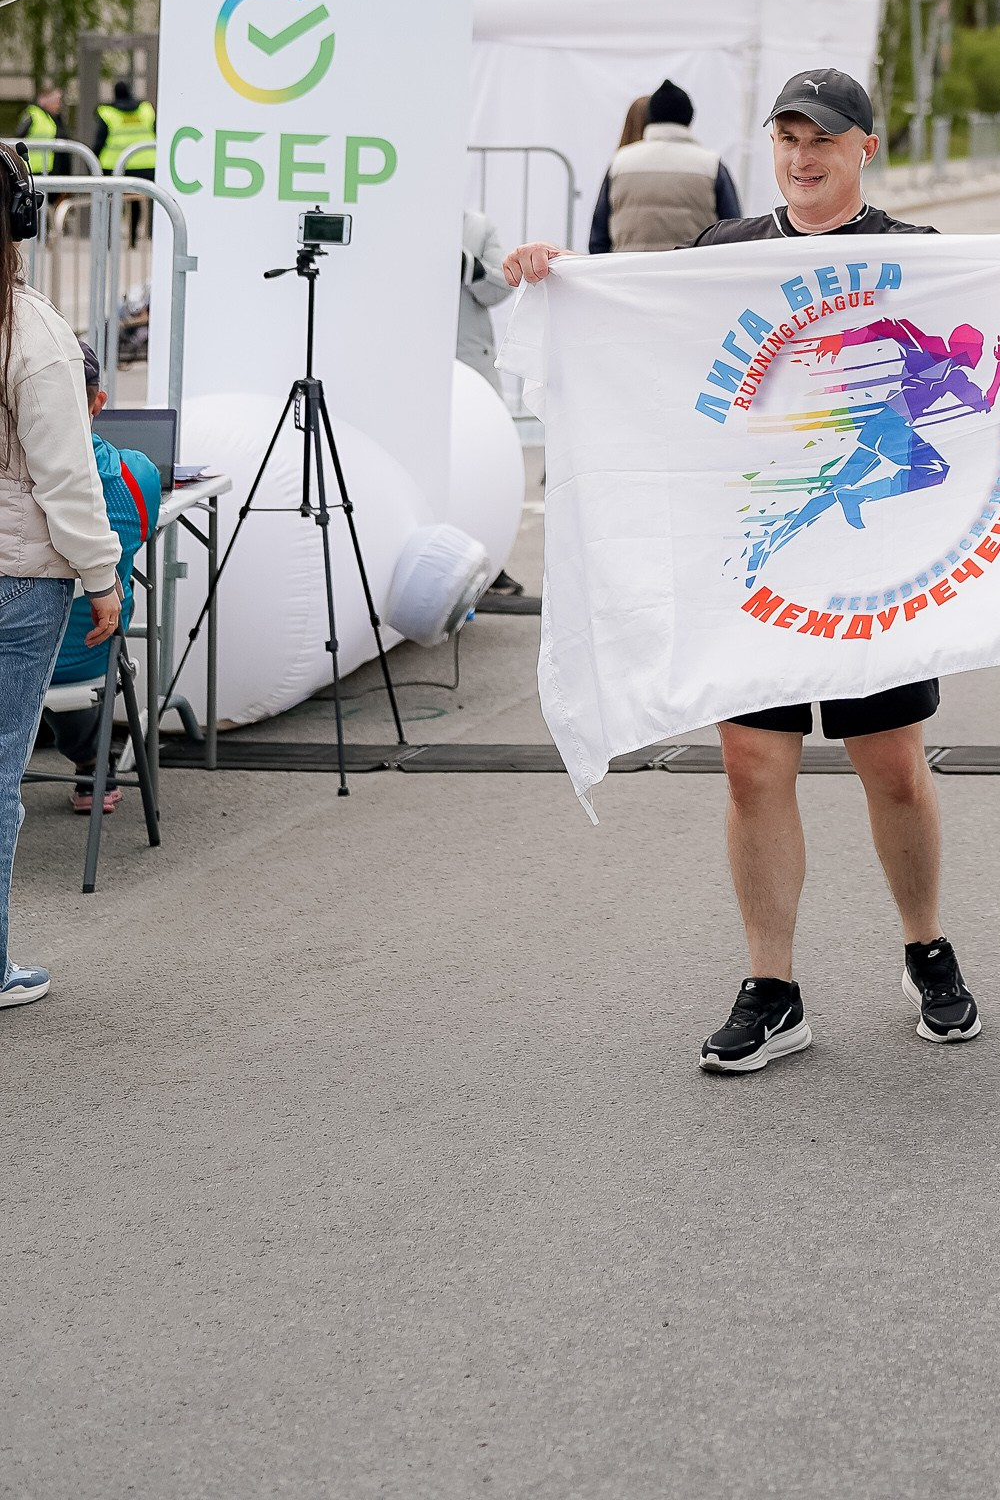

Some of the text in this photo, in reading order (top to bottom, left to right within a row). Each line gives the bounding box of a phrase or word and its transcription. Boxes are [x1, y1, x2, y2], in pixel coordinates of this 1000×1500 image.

[169, 126, 398, 204] СБЕР
[694, 262, 903, 425] ЛИГА БЕГА
[733, 290, 875, 411] RUNNING LEAGUE
